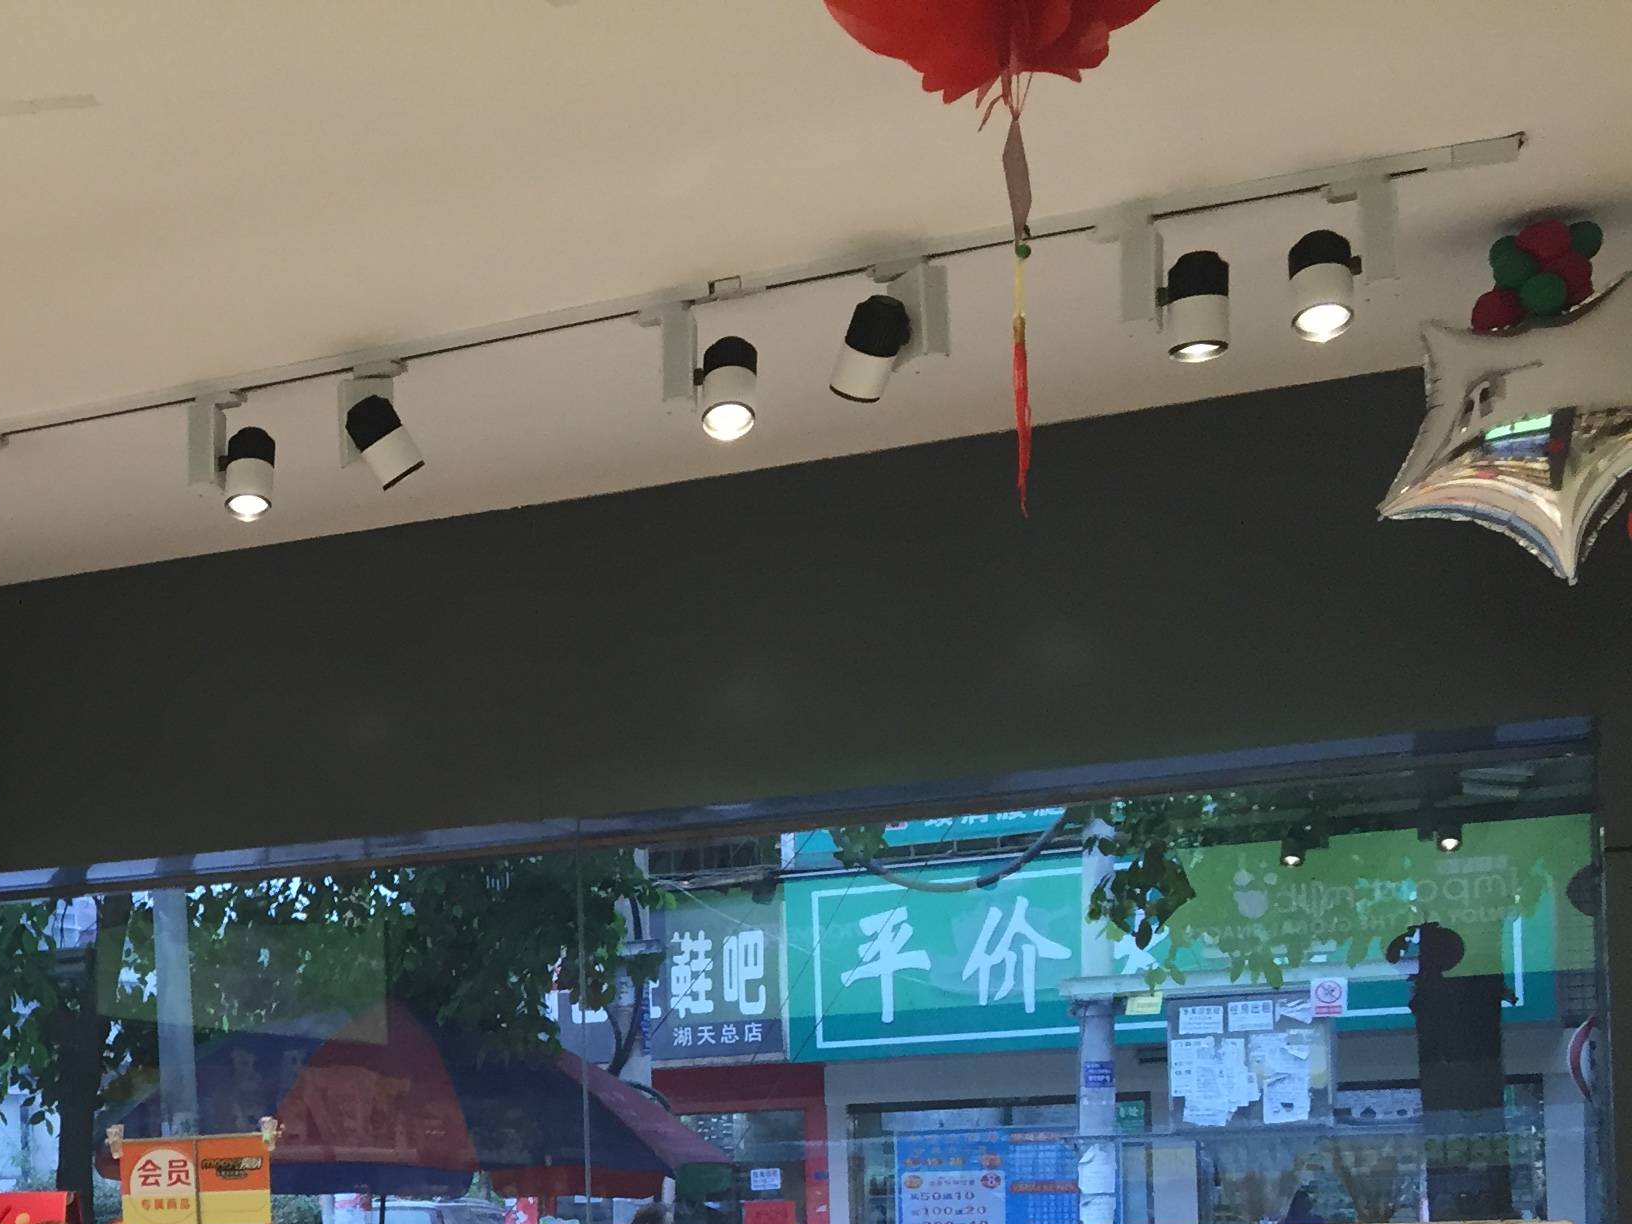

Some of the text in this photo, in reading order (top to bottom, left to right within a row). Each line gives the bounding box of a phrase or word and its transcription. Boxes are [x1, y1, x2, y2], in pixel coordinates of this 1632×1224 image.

[650, 928, 766, 1018] 鞋吧
[673, 1022, 763, 1047] 湖天总店
[138, 1160, 190, 1186] 会员
